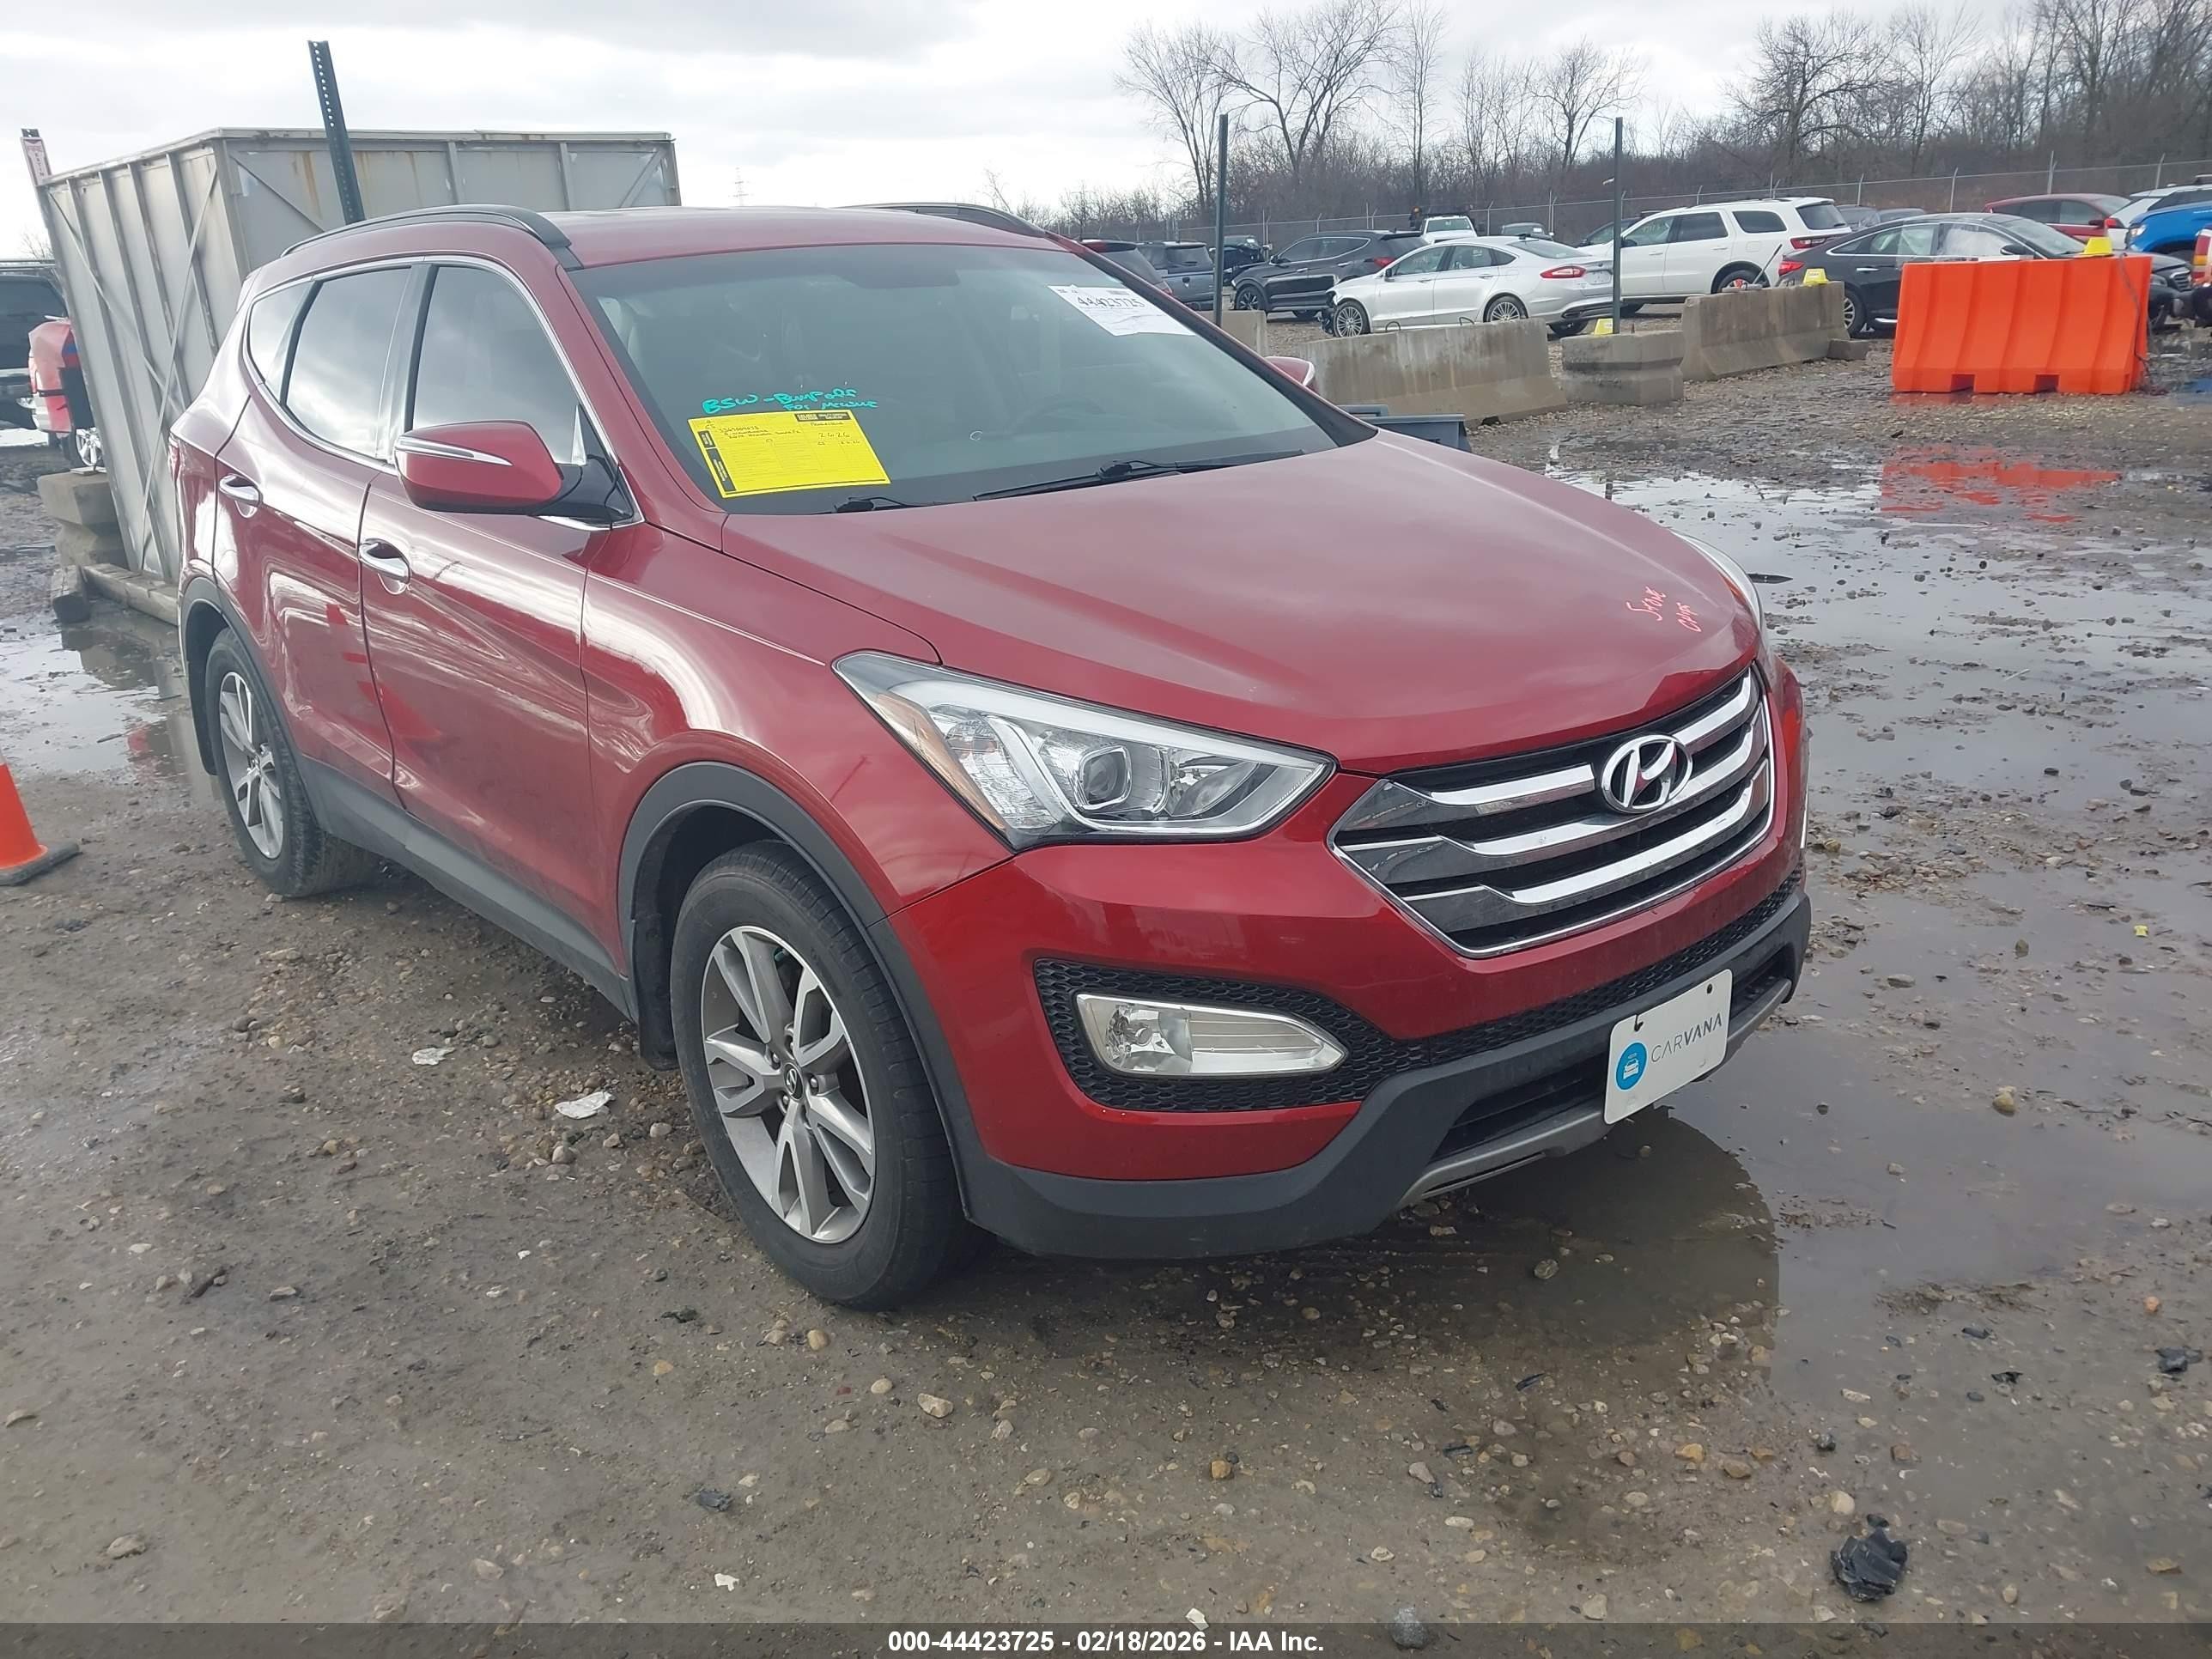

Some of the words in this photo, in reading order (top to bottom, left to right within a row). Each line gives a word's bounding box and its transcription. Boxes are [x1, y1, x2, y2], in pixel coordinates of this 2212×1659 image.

[1077, 296, 1146, 308] 44423725
[702, 394, 759, 414] BSW
[1650, 1012, 1723, 1063] CARVANA
